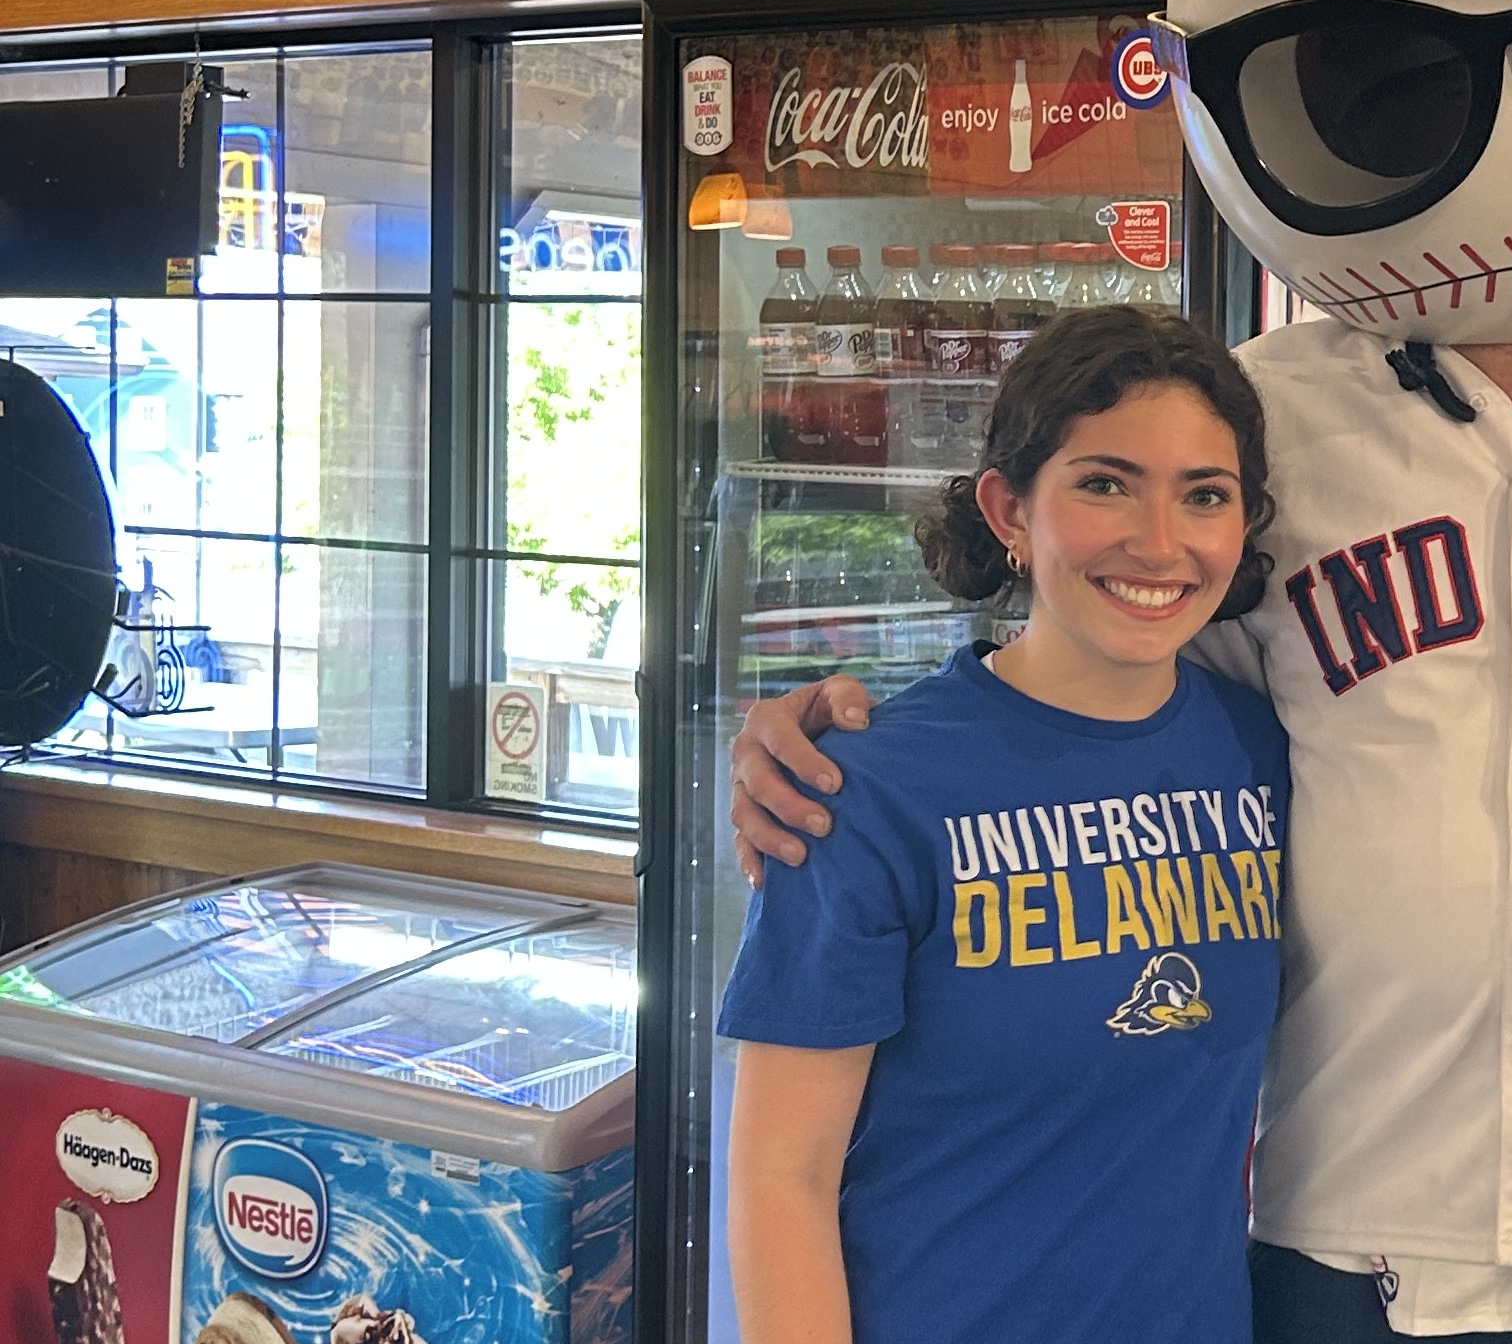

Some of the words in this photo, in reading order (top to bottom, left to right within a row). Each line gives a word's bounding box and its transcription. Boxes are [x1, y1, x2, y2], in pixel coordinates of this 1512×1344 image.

[688, 69, 727, 83] BALANCE
[700, 92, 715, 103] EAT
[695, 104, 721, 117] DRINK
[765, 62, 929, 172] Coca-Cola
[941, 105, 998, 132] enjoy
[1042, 100, 1072, 124] ice
[1078, 99, 1127, 121] cold
[706, 117, 718, 128] DO
[944, 789, 1228, 881] UNIVERSITY
[1237, 785, 1277, 849] OF
[63, 1132, 152, 1175] Häagen-Dazs
